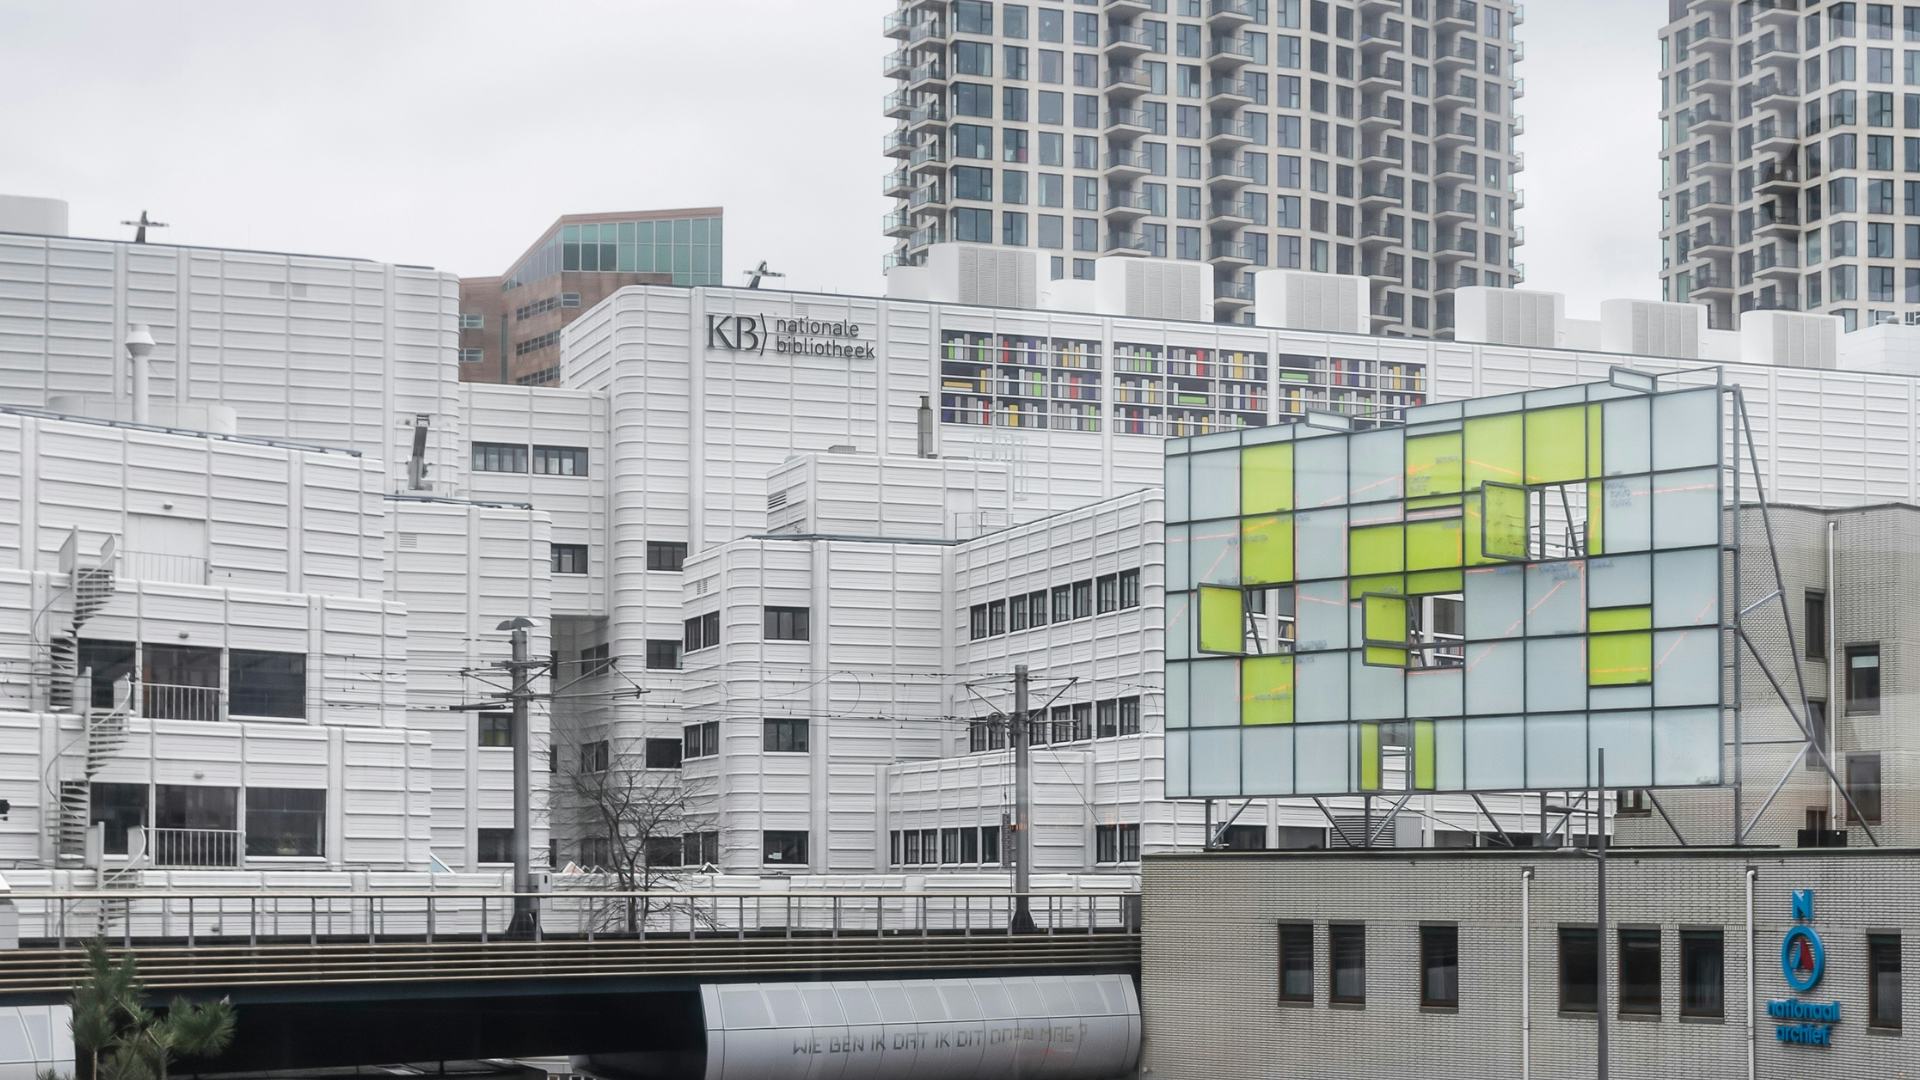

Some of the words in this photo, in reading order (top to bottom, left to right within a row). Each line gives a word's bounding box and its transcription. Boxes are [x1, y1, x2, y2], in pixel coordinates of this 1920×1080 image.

[706, 314, 759, 351] KB
[776, 316, 859, 337] nationale
[776, 336, 876, 359] bibliotheek
[1767, 997, 1841, 1021] nationaal
[793, 1036, 822, 1055] WIE
[871, 1033, 886, 1051] IK
[893, 1031, 928, 1050] DAT
[936, 1030, 951, 1049] IK
[957, 1029, 983, 1048] DIT
[1775, 1024, 1831, 1045] archief
